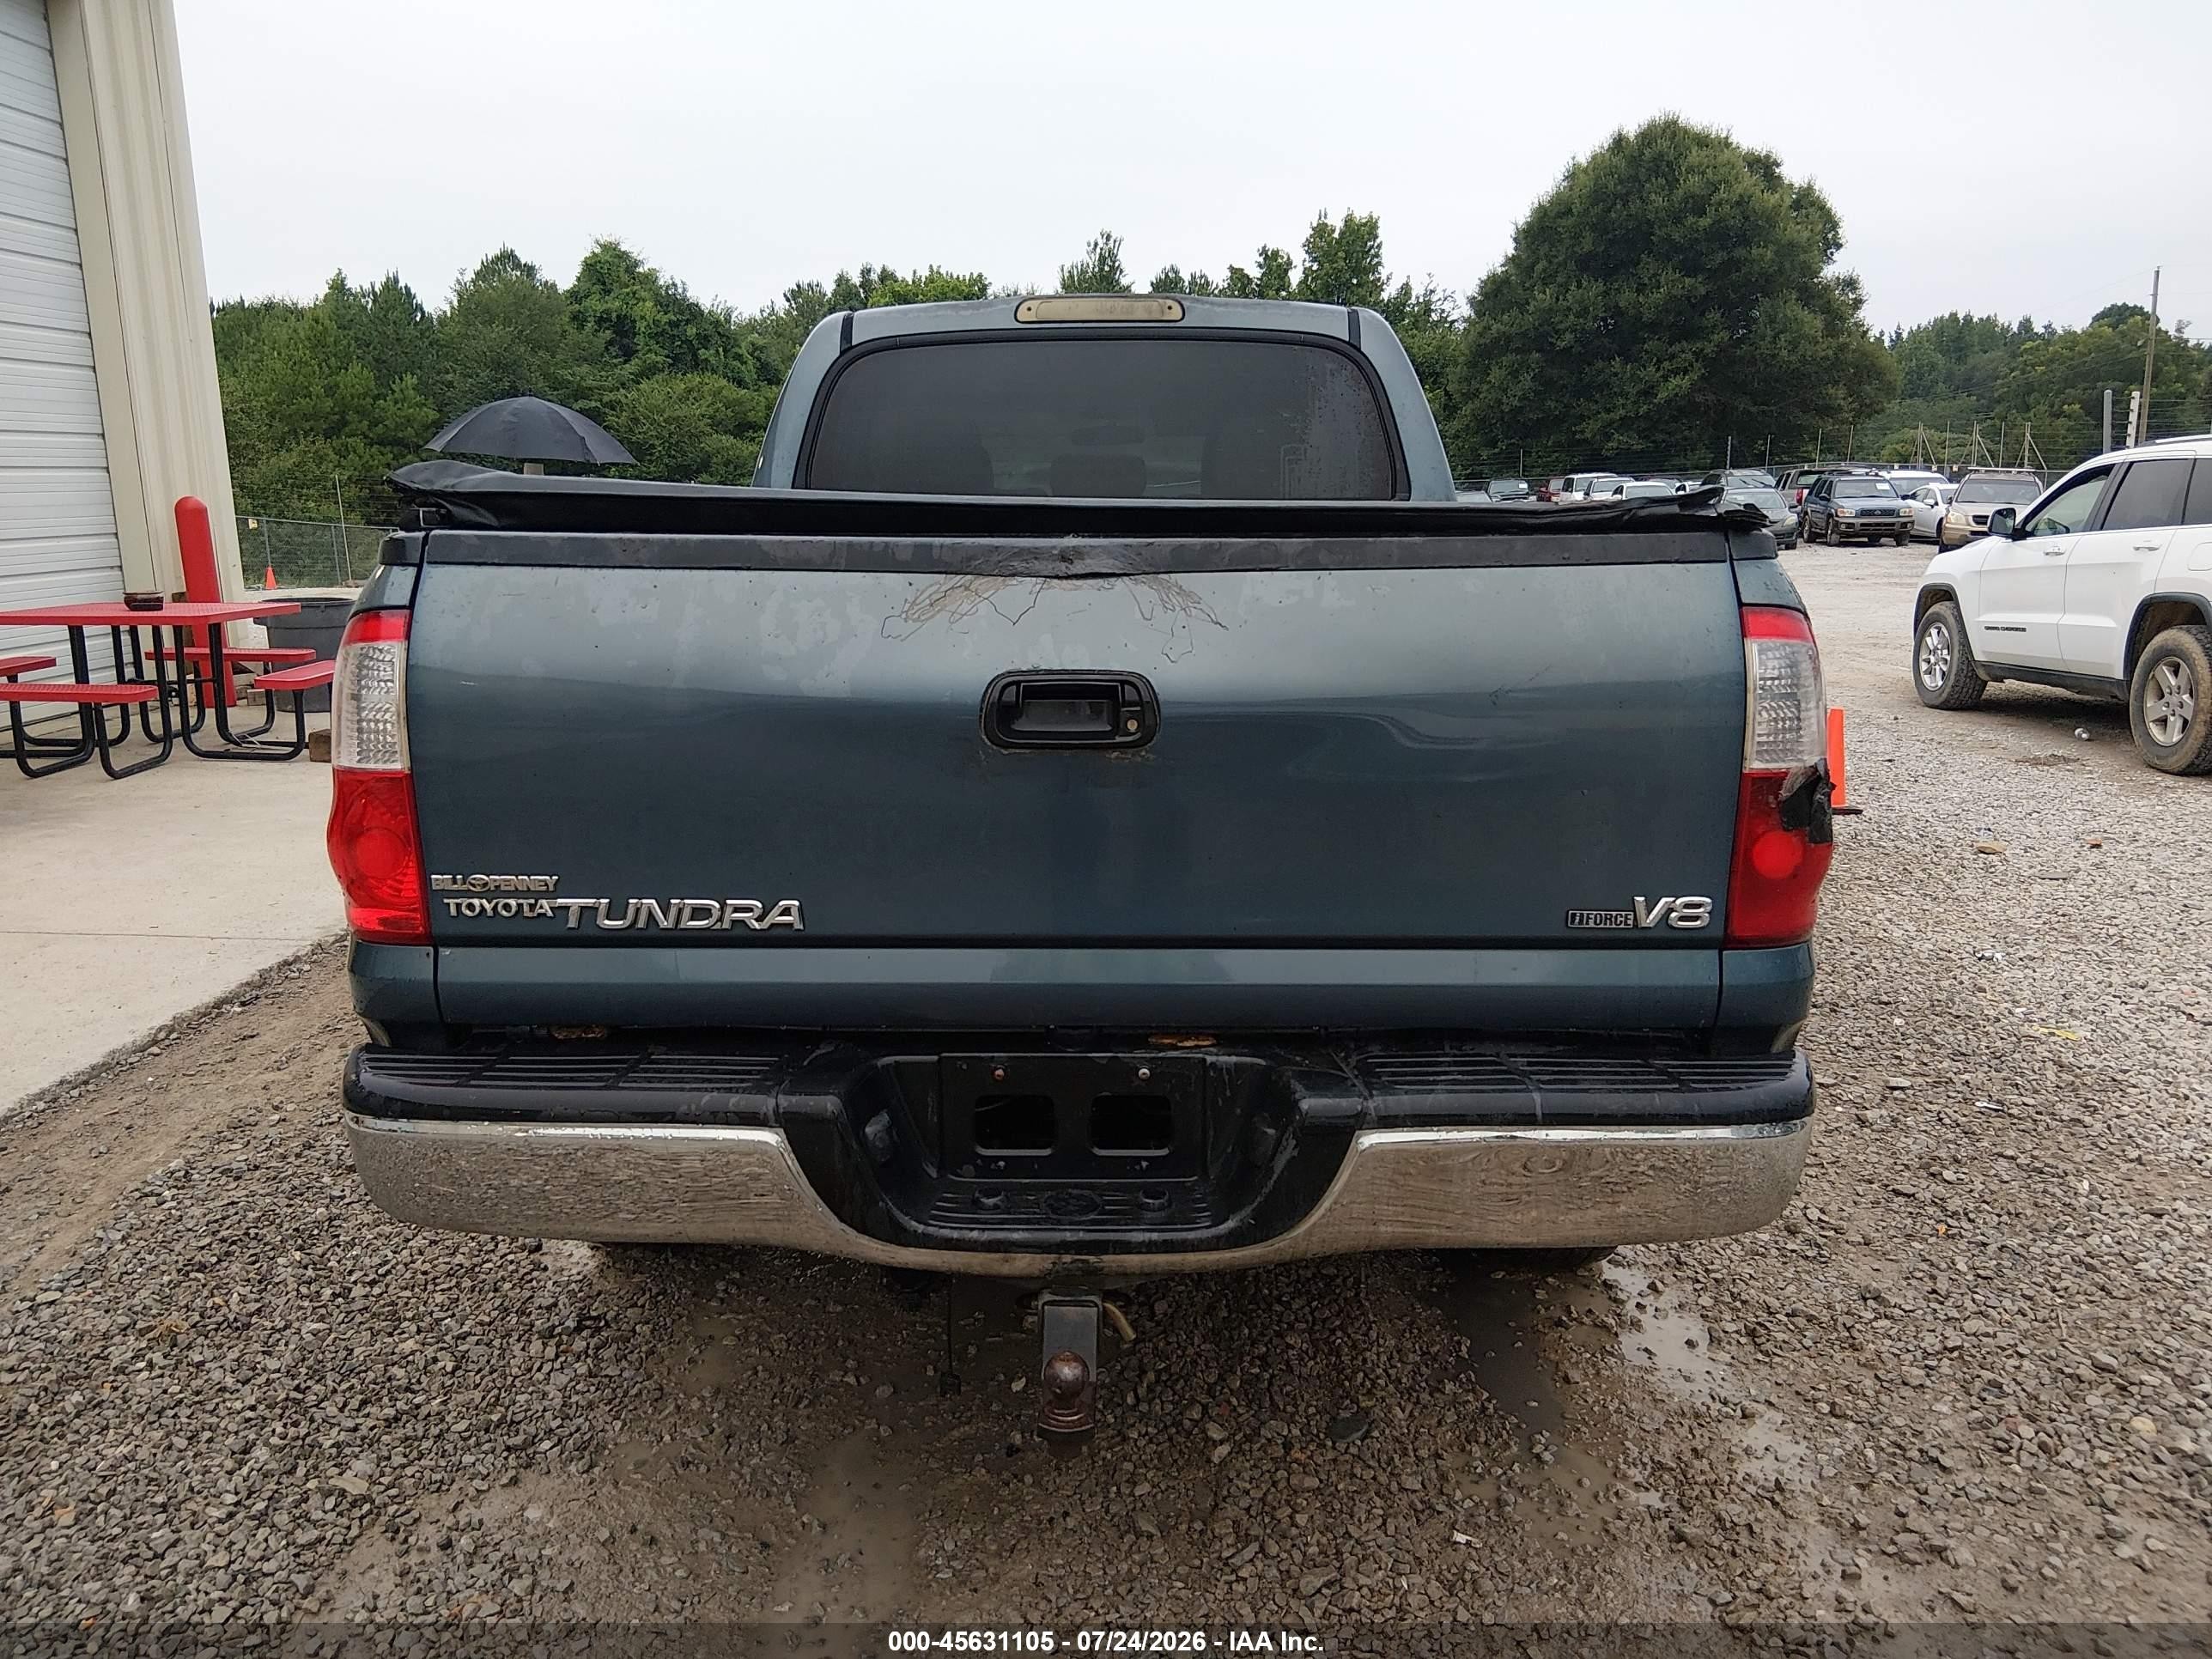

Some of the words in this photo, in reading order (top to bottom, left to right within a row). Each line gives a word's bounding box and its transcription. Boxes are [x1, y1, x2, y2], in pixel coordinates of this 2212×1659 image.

[430, 874, 468, 890] BILL
[489, 875, 559, 891] PENNEY
[443, 898, 555, 917] TOYOTA
[556, 898, 804, 930] TUNDRA
[1633, 896, 1713, 928] V8
